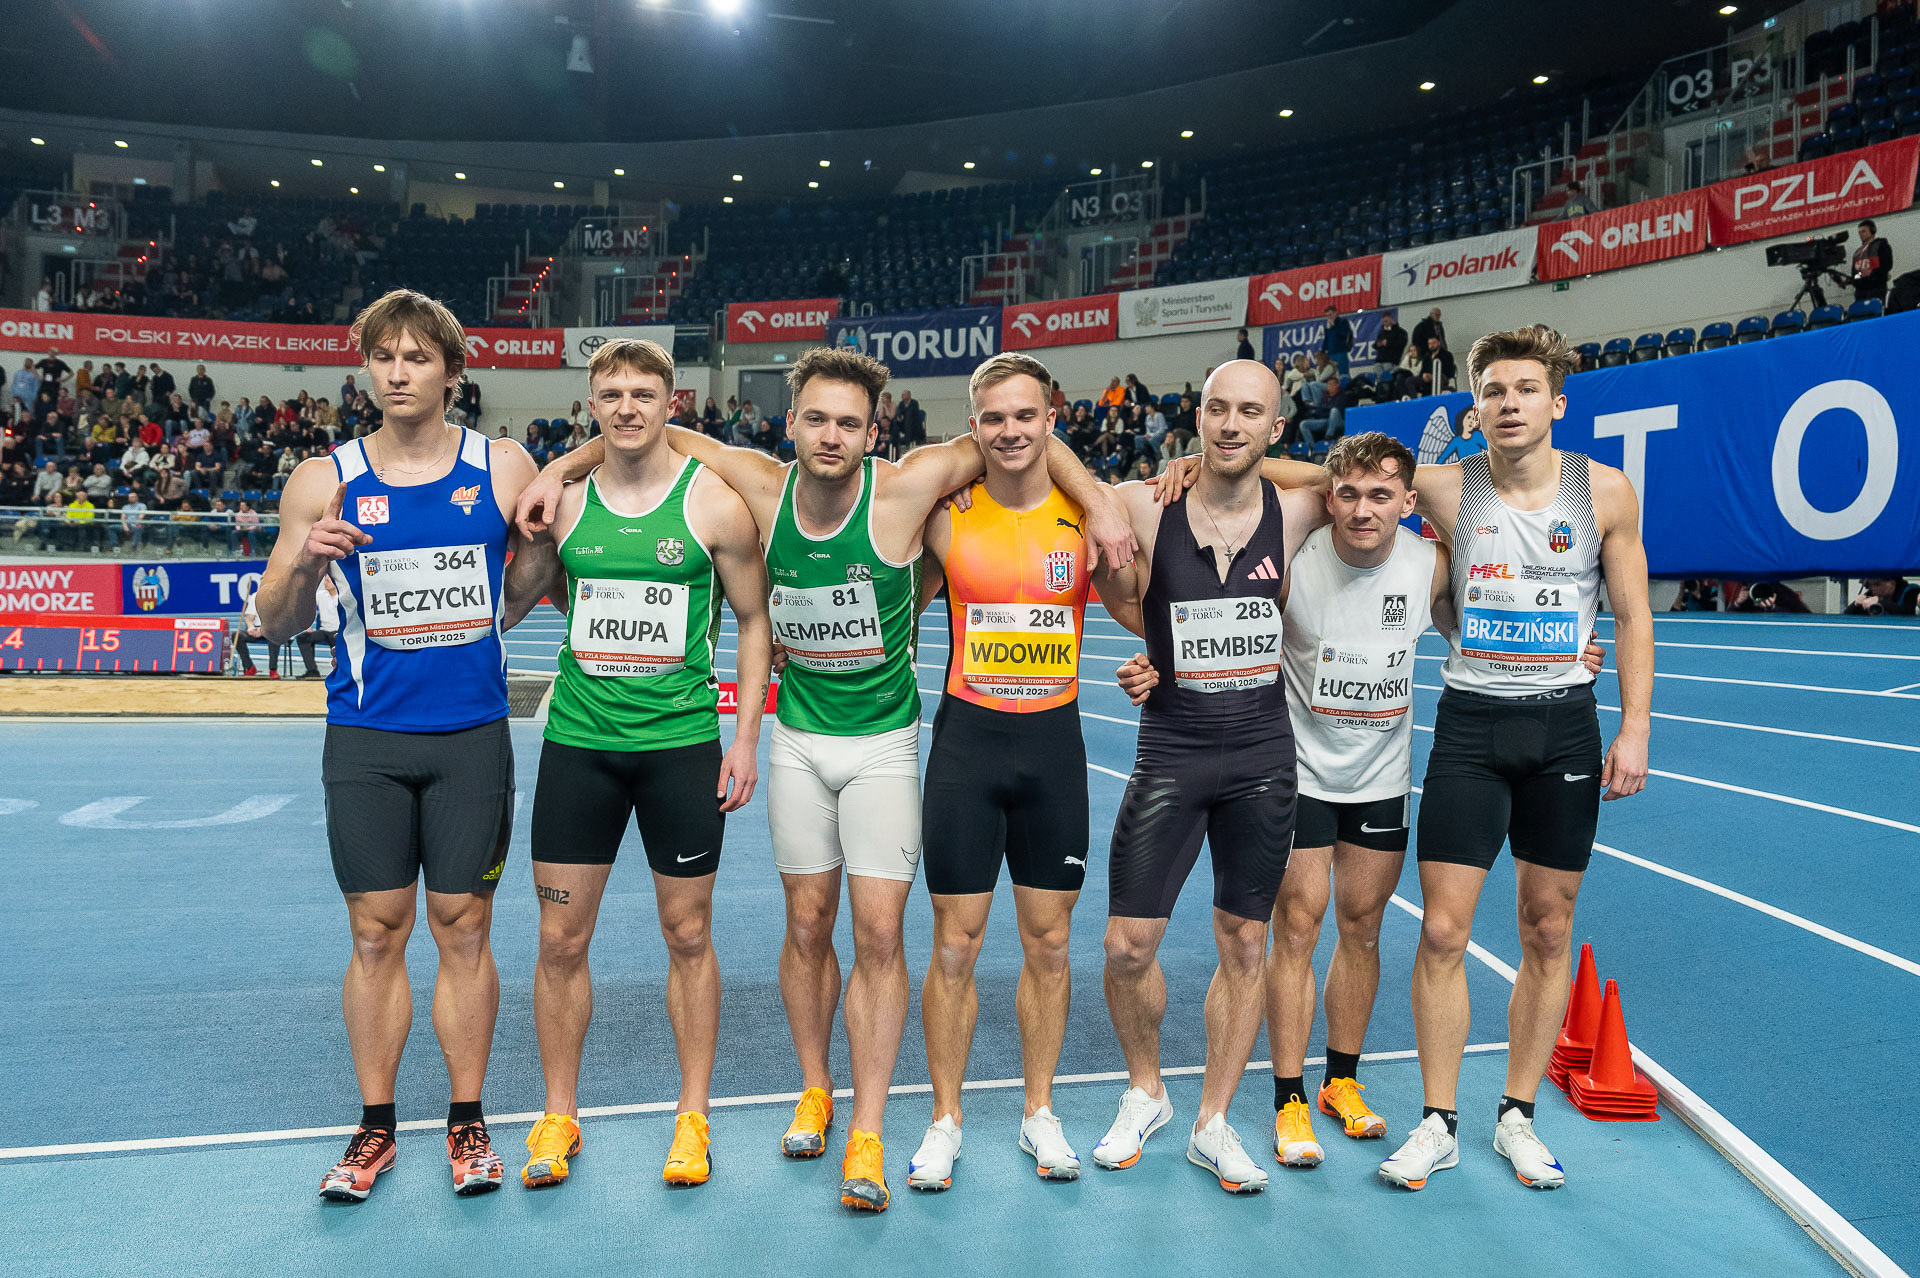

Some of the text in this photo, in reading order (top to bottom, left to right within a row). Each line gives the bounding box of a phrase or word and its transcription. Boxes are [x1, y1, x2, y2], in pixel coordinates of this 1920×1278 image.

[1669, 54, 1771, 104] O3 P3
[1734, 159, 1883, 220] PZLA
[32, 204, 109, 229] L3 M3
[1072, 196, 1100, 219] N3
[1734, 221, 1763, 231] POLSKI
[1842, 195, 1885, 209] ATLETYKI
[1600, 209, 1694, 249] ORLEN
[585, 229, 649, 249] M3 N3
[1425, 246, 1519, 286] polanik
[1299, 272, 1371, 301] ORLEN
[1162, 294, 1215, 305] Ministerstwo
[770, 310, 829, 328] ORLEN
[1162, 308, 1188, 318] Sportu
[1195, 301, 1232, 314] Turystyki
[1046, 308, 1109, 331] ORLEN
[1, 320, 73, 340] ORLEN
[95, 327, 171, 345] POLSKI
[177, 332, 271, 351] ZWIĄZEK
[275, 337, 350, 351] LEKKIEJ
[870, 315, 994, 361] TORUŃ
[1279, 319, 1362, 348] KUJAY
[494, 339, 555, 355] ORLEN
[451, 485, 480, 501] AWF
[382, 560, 419, 572] TORUŃ
[433, 550, 476, 571] 364
[1469, 564, 1516, 580] MKL
[371, 585, 486, 618] ŁĘCZYCKI
[595, 590, 625, 600] TORUŃ
[644, 586, 673, 606] 80
[784, 597, 813, 606] TORUŃ
[832, 587, 859, 606] 81
[1483, 593, 1515, 603] TORUŃ
[1535, 588, 1562, 606] 61
[985, 614, 1016, 624] TORUŃ
[1029, 609, 1066, 628] 284
[1191, 609, 1223, 620] TORUŃ
[1235, 601, 1273, 620] 283
[403, 626, 429, 634] Halowe
[429, 621, 470, 631] Mistrzostwa
[588, 618, 668, 643] KRUPA
[775, 617, 877, 641] LEMPACH
[1466, 617, 1574, 643] BRZEZIŃSKI
[0, 627, 24, 650] 4
[83, 628, 121, 652] 15
[177, 631, 214, 653] 16
[400, 632, 466, 646] TORUŃ 2025
[1181, 634, 1278, 660] REMBISZ
[624, 654, 662, 663] Mistrzostwa
[970, 642, 1072, 665] WDOWIK
[1338, 655, 1369, 665] TORUŃ
[1386, 650, 1407, 668] 17
[596, 663, 657, 673] TORUŃ 2025
[805, 659, 835, 668] TORUŃ
[1488, 662, 1522, 672] TORUŃ
[990, 686, 1049, 696] TORUŃ 2025
[1203, 677, 1258, 689] TORUŃ 2025
[1319, 677, 1408, 701] ŁUCZYŃSKI
[1336, 718, 1367, 726] TORUŃ
[537, 884, 570, 905] 2002
